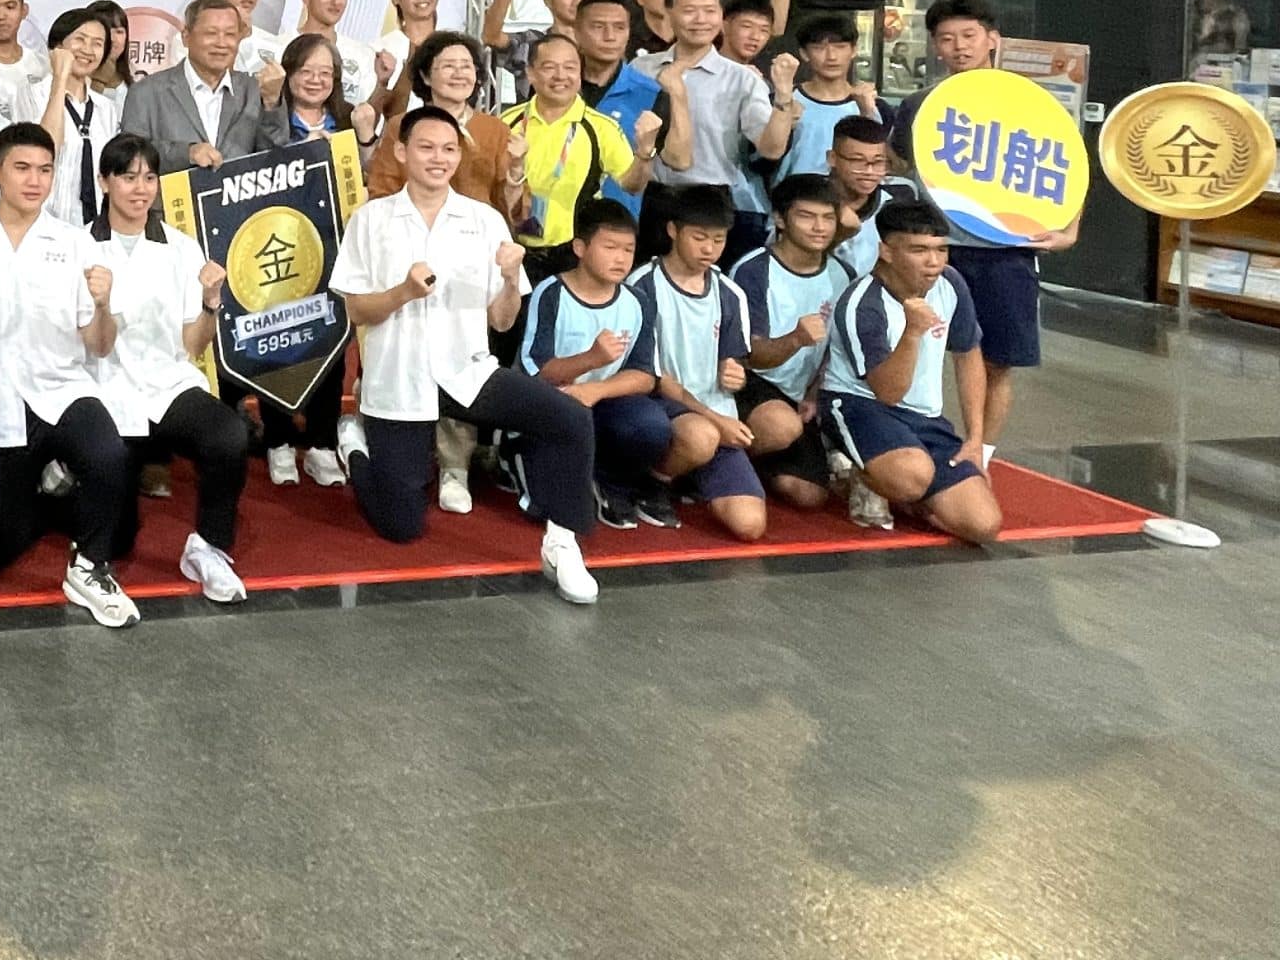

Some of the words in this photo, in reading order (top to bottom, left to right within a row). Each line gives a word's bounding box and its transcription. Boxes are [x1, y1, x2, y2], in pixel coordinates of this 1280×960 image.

[933, 107, 1070, 205] 划船
[1151, 124, 1221, 178] 金
[222, 158, 306, 206] NSSAG
[254, 232, 300, 287] 金
[244, 300, 322, 332] CHAMPIONS
